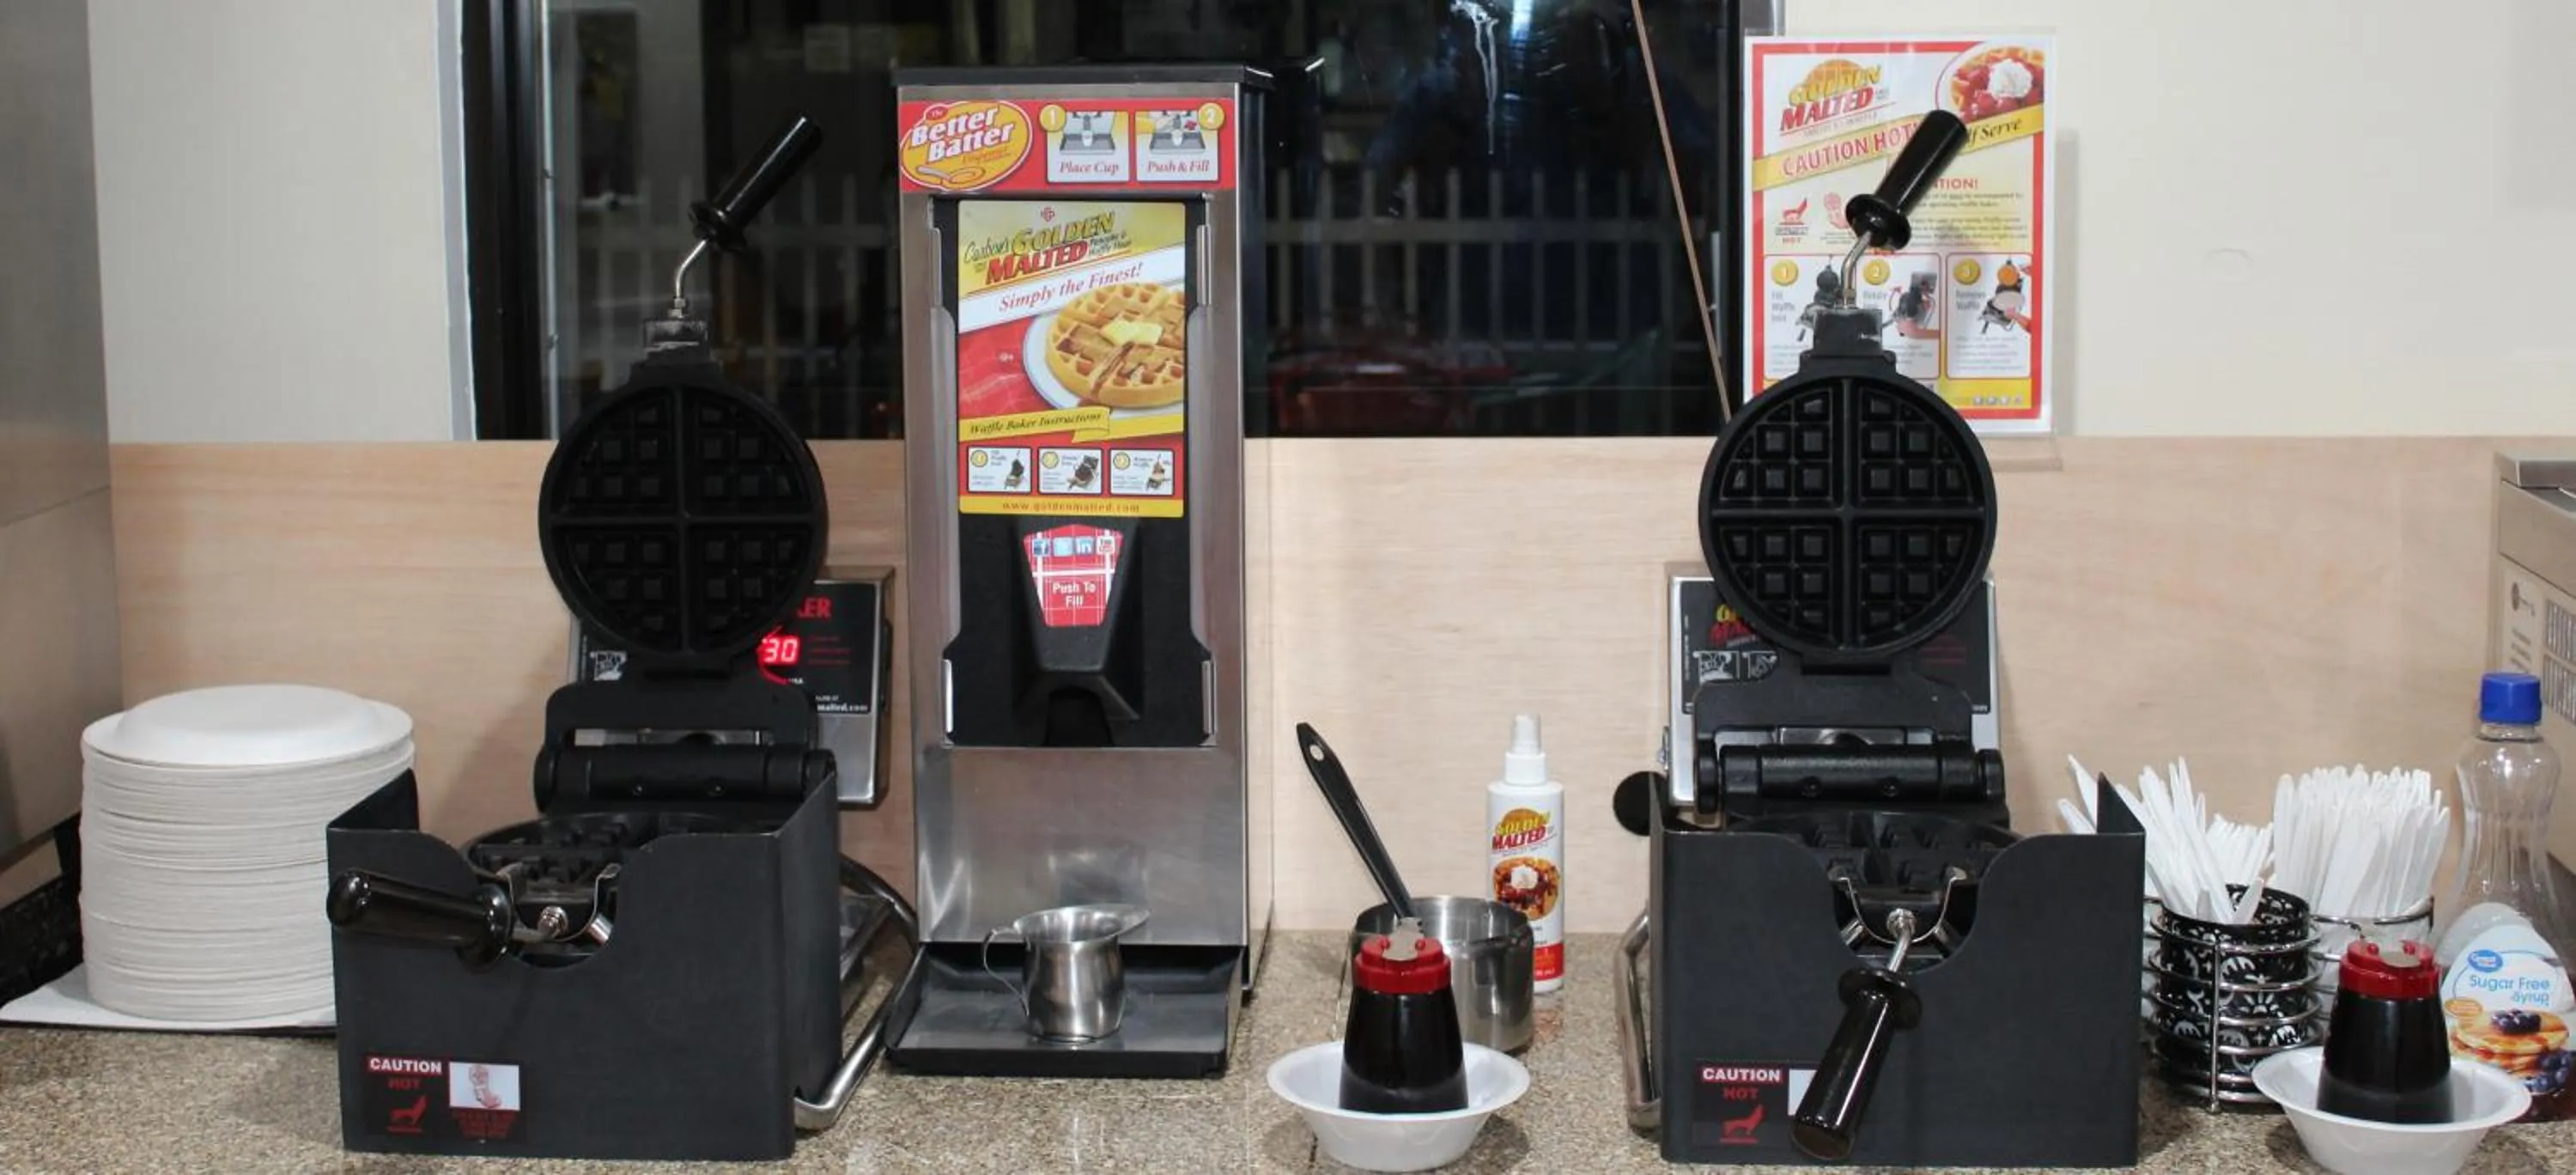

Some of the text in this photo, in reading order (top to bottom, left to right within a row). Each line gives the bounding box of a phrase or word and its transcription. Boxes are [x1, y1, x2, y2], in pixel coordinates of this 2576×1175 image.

[1789, 64, 1881, 106] GOLDEN
[1779, 87, 1874, 131] MALTED
[911, 107, 999, 147] Better
[927, 123, 1014, 162] Batter
[1783, 137, 1869, 177] CAUTION
[1980, 118, 2022, 141] Serve
[1060, 161, 1120, 176] Place Cup
[1147, 160, 1210, 174] Push & Fill
[1012, 210, 1115, 256] GOLDEN
[985, 240, 1089, 285] MALTED
[999, 261, 1144, 312] Simply the Finest!
[970, 412, 1102, 434] Waffle Baker Instructions
[1052, 581, 1097, 594] Push To
[1065, 594, 1084, 608] Fill
[1492, 824, 1546, 849] MALTED
[2470, 974, 2550, 991] Sugar Free
[2512, 991, 2549, 1007] Syrup
[369, 1057, 442, 1074] CAUTION
[1702, 1067, 1783, 1082] CAUTION
[389, 1078, 421, 1091] HOT
[1723, 1087, 1759, 1099] HOT
